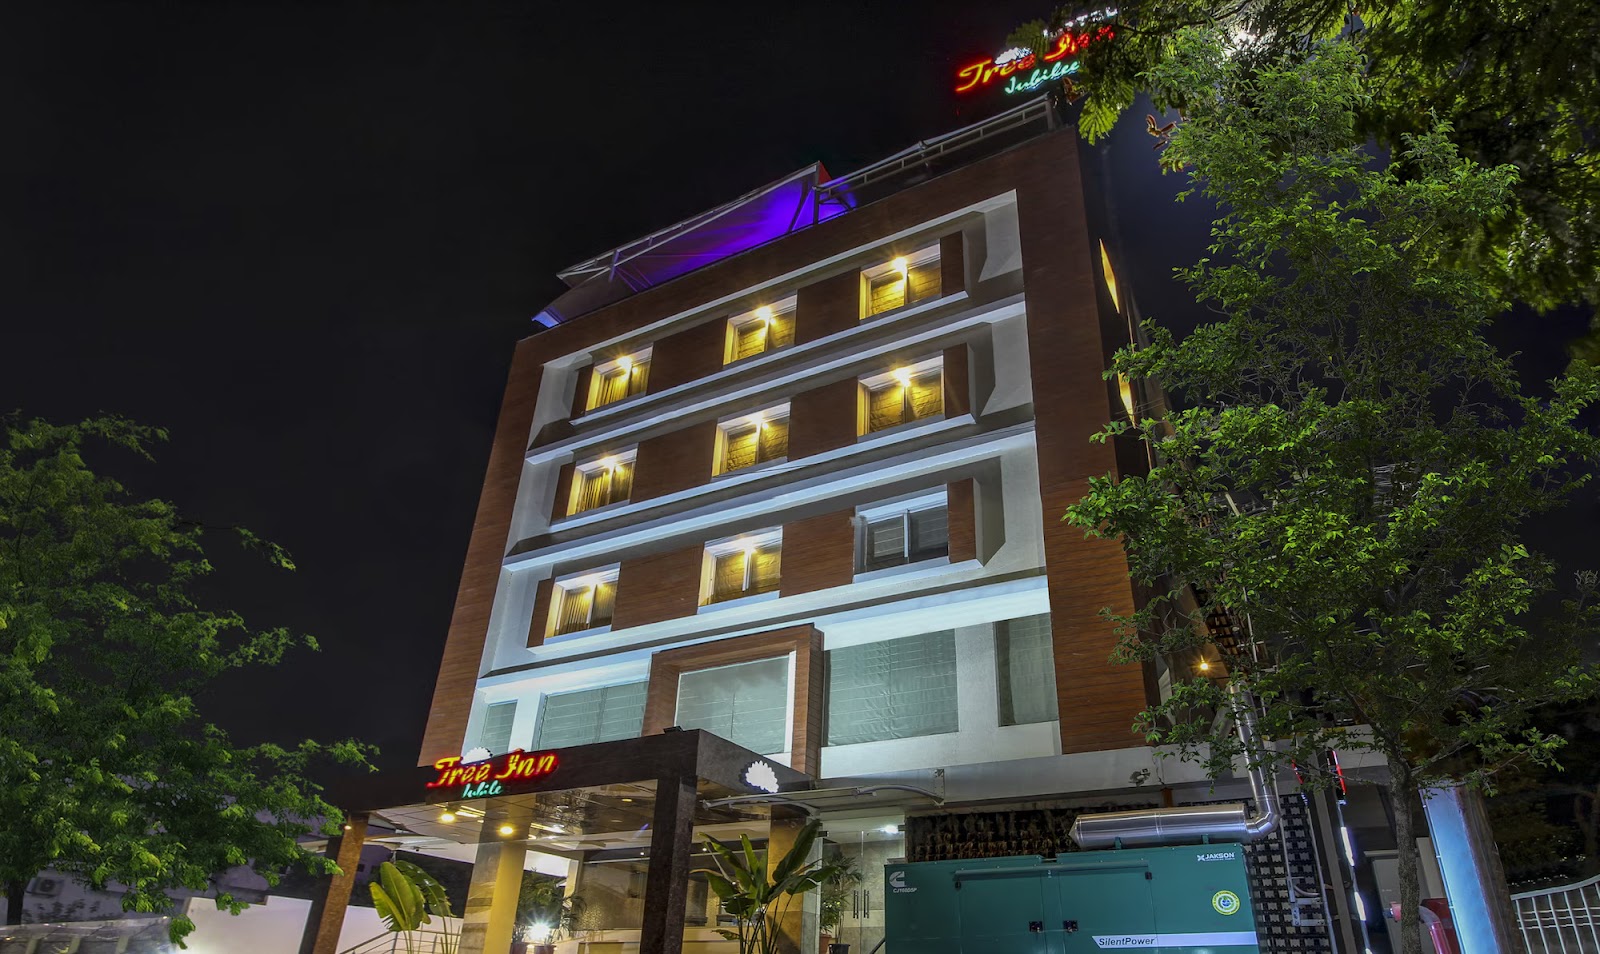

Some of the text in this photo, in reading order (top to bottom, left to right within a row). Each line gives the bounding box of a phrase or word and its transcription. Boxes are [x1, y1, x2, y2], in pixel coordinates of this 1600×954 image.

[956, 53, 1036, 92] Tree
[1004, 60, 1080, 94] Jubilee
[427, 749, 556, 787] Tree Inn
[1099, 937, 1155, 946] SilentPower
